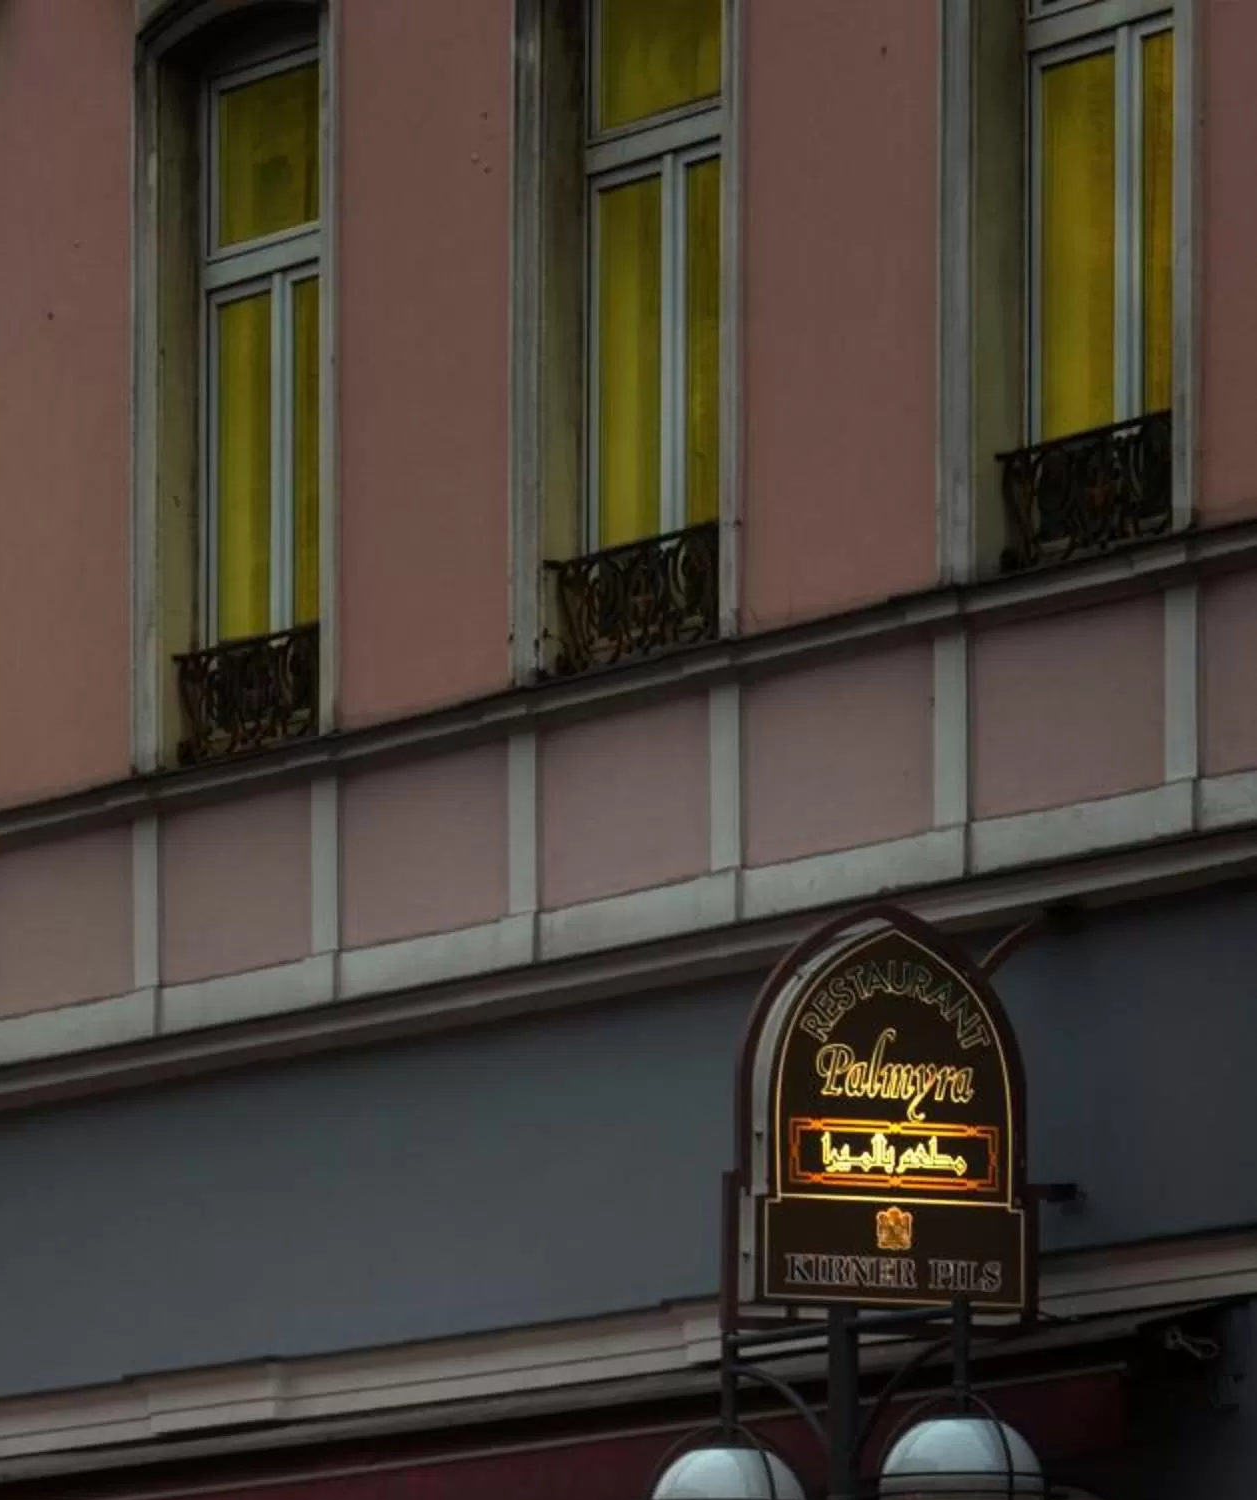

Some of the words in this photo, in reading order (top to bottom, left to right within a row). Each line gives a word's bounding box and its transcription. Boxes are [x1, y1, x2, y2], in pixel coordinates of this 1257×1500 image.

[800, 960, 991, 1049] RESTAURANT
[816, 1028, 975, 1121] Palmyra
[896, 1135, 967, 1177] مطعم
[783, 1252, 918, 1288] KIRNER
[927, 1259, 1003, 1291] PILS
